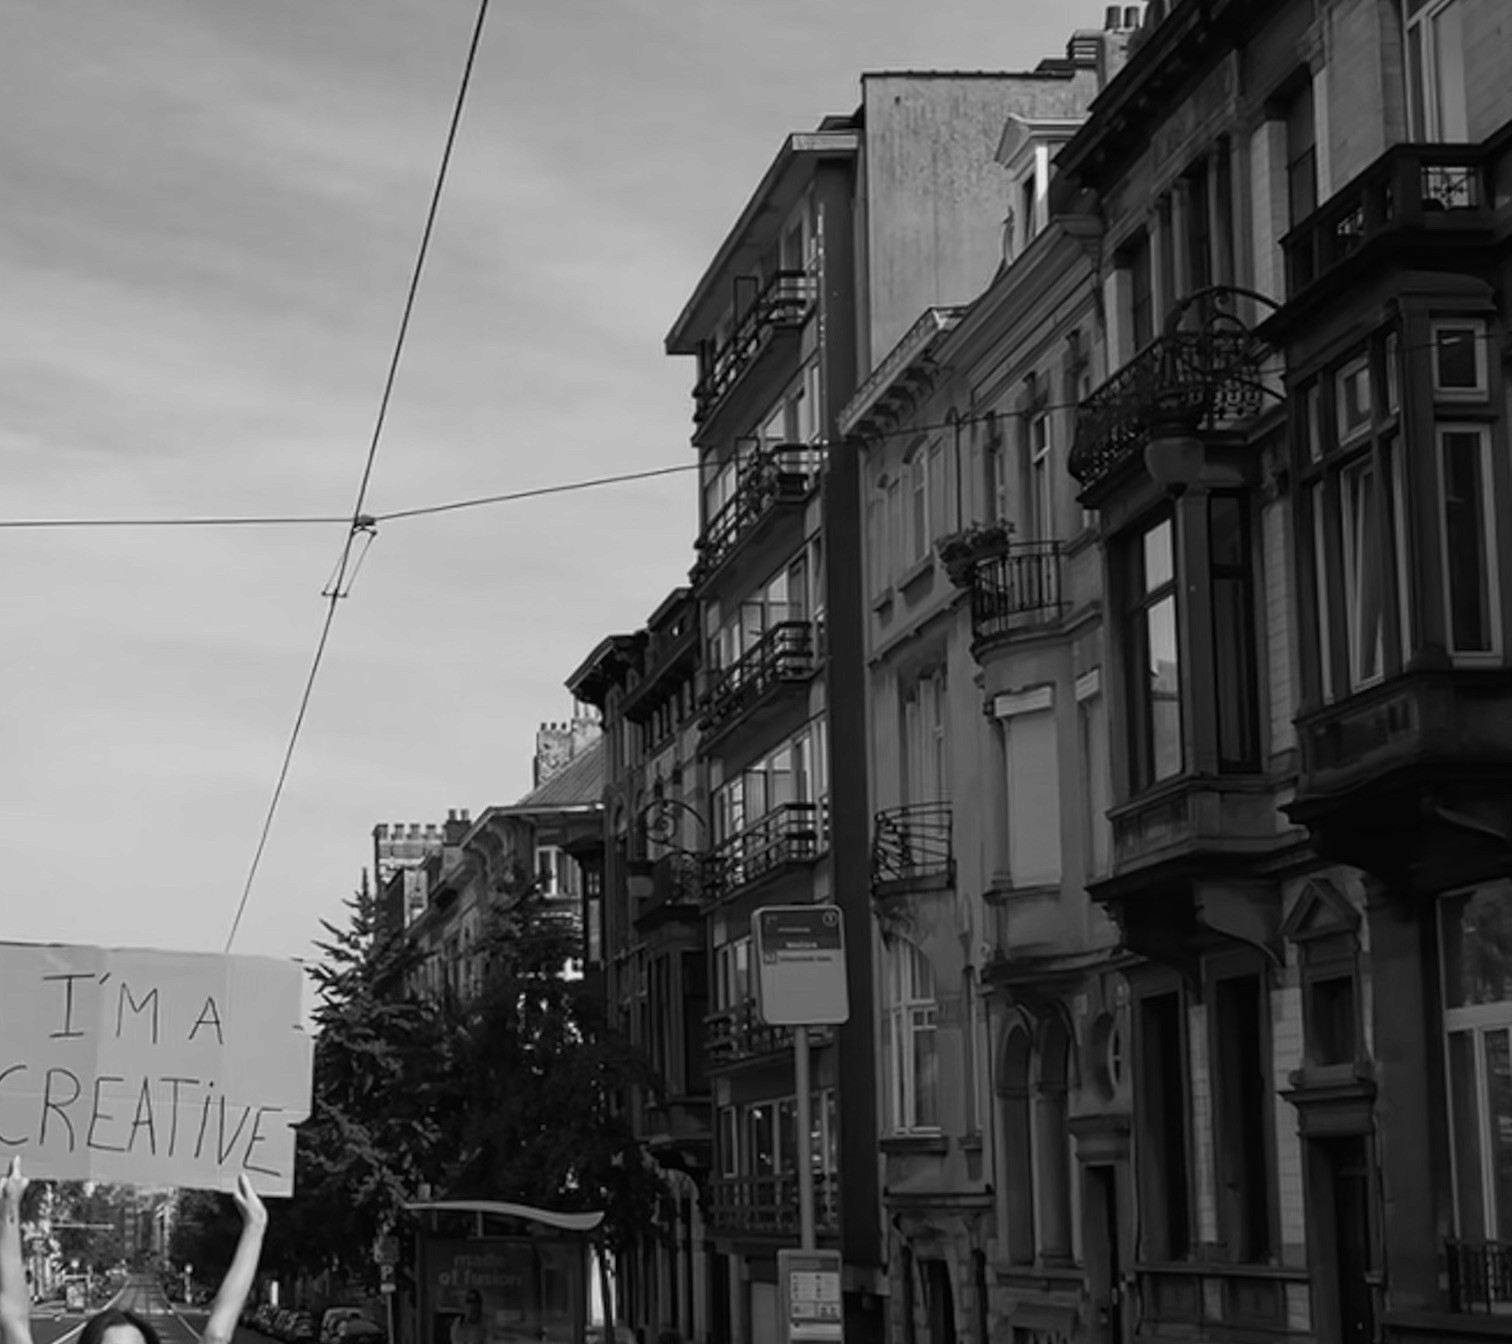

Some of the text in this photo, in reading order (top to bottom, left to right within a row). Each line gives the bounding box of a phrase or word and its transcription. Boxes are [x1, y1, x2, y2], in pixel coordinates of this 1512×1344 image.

[41, 972, 225, 1045] I'M A
[453, 1253, 506, 1267] made
[438, 1268, 522, 1286] of fusion
